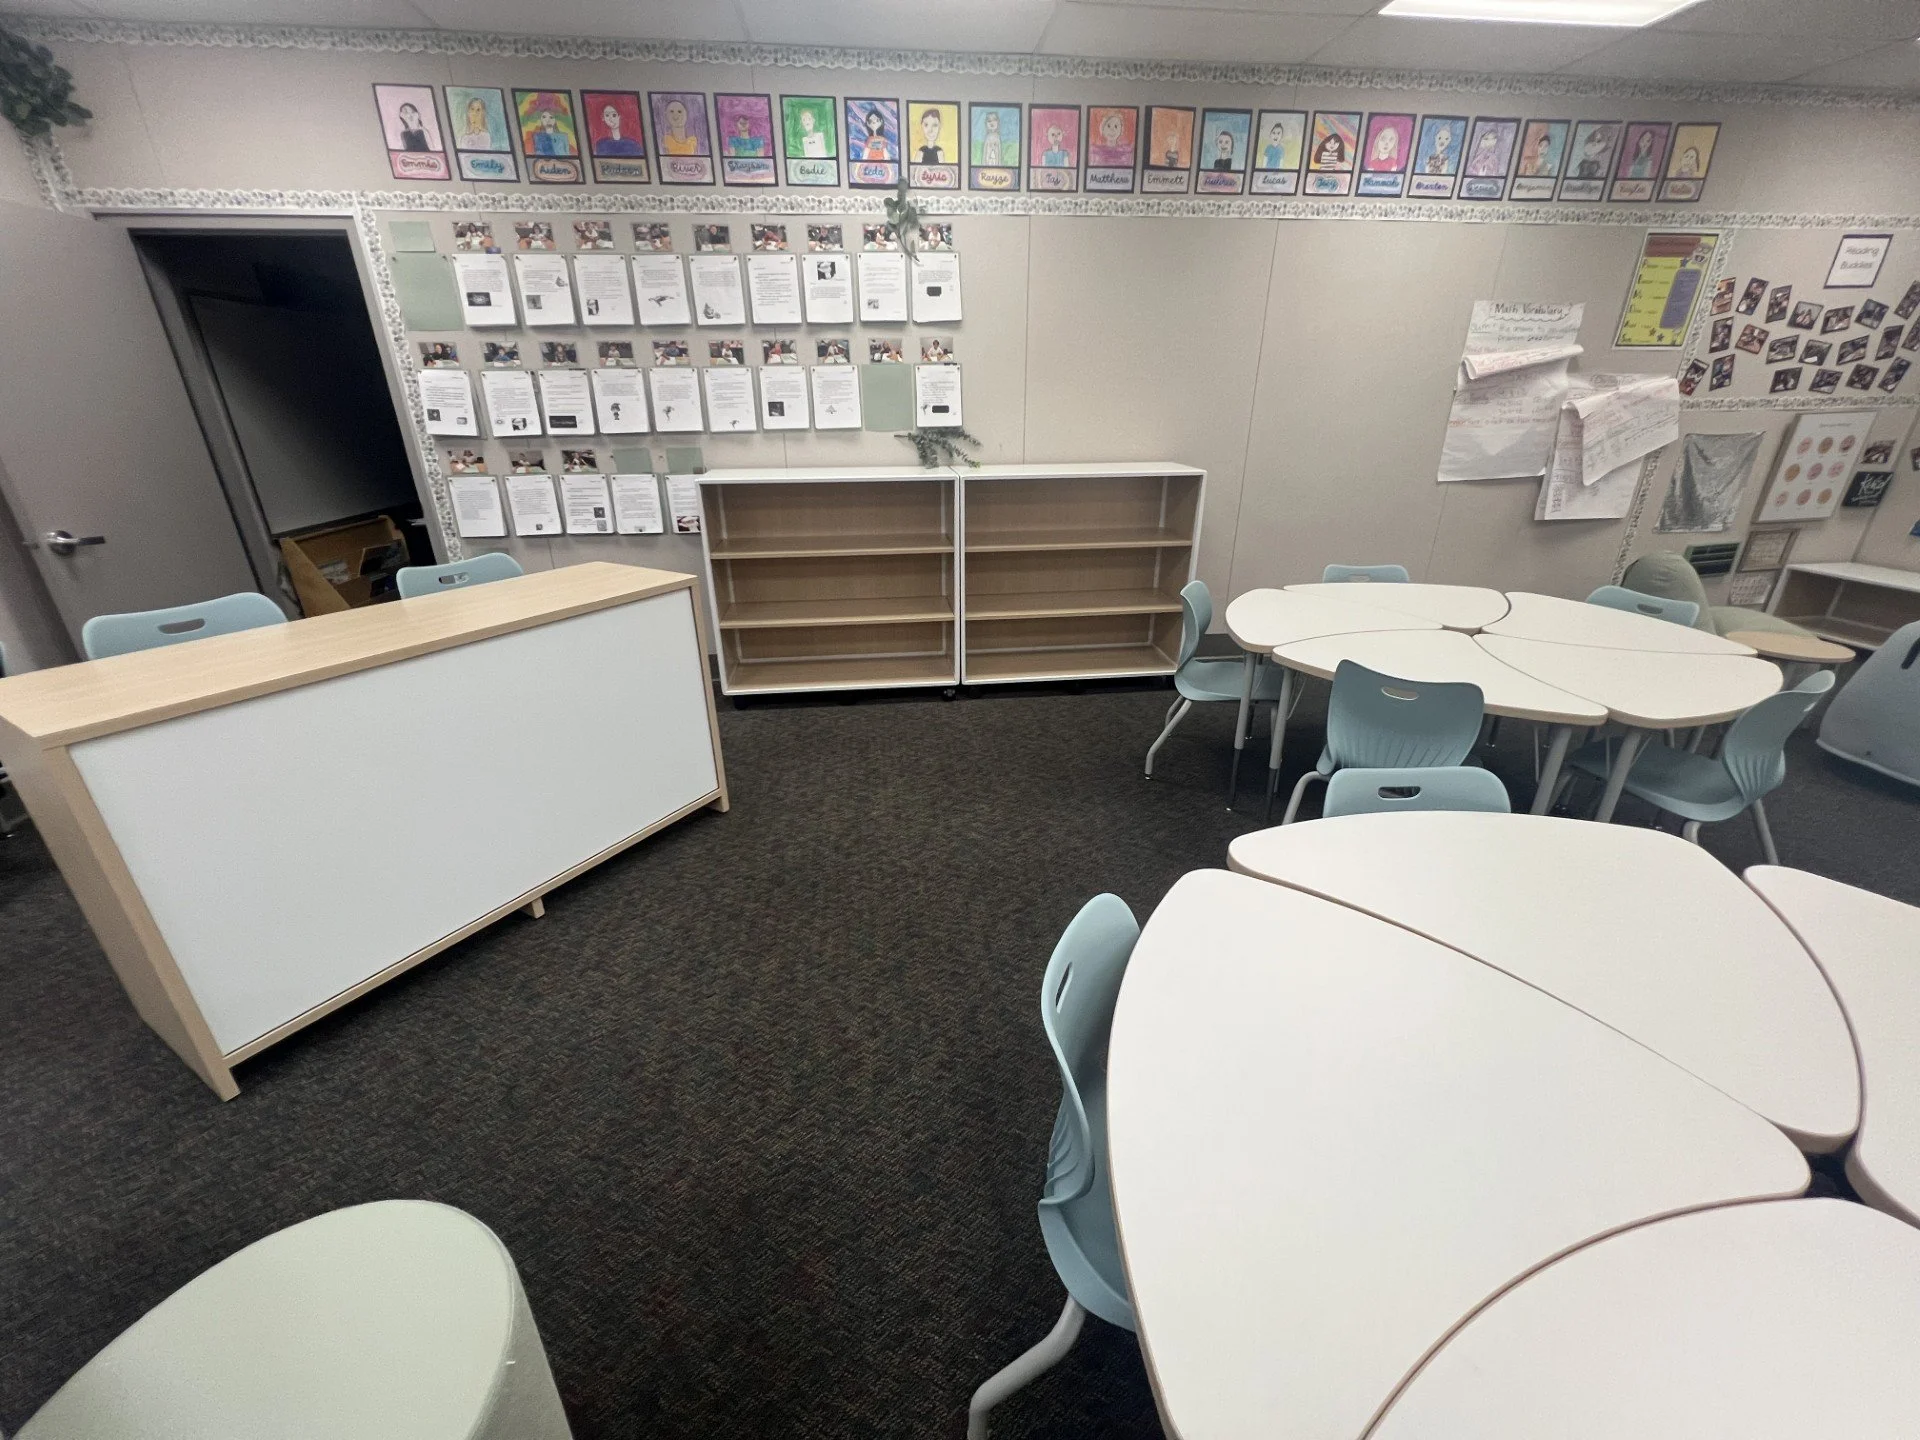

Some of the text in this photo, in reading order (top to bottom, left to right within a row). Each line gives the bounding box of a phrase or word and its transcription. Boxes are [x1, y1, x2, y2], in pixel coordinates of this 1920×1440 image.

[1089, 173, 1130, 184] Matthew
[1147, 174, 1184, 184] Emmett
[1261, 175, 1287, 184] Lucas
[1495, 303, 1519, 314] Math
